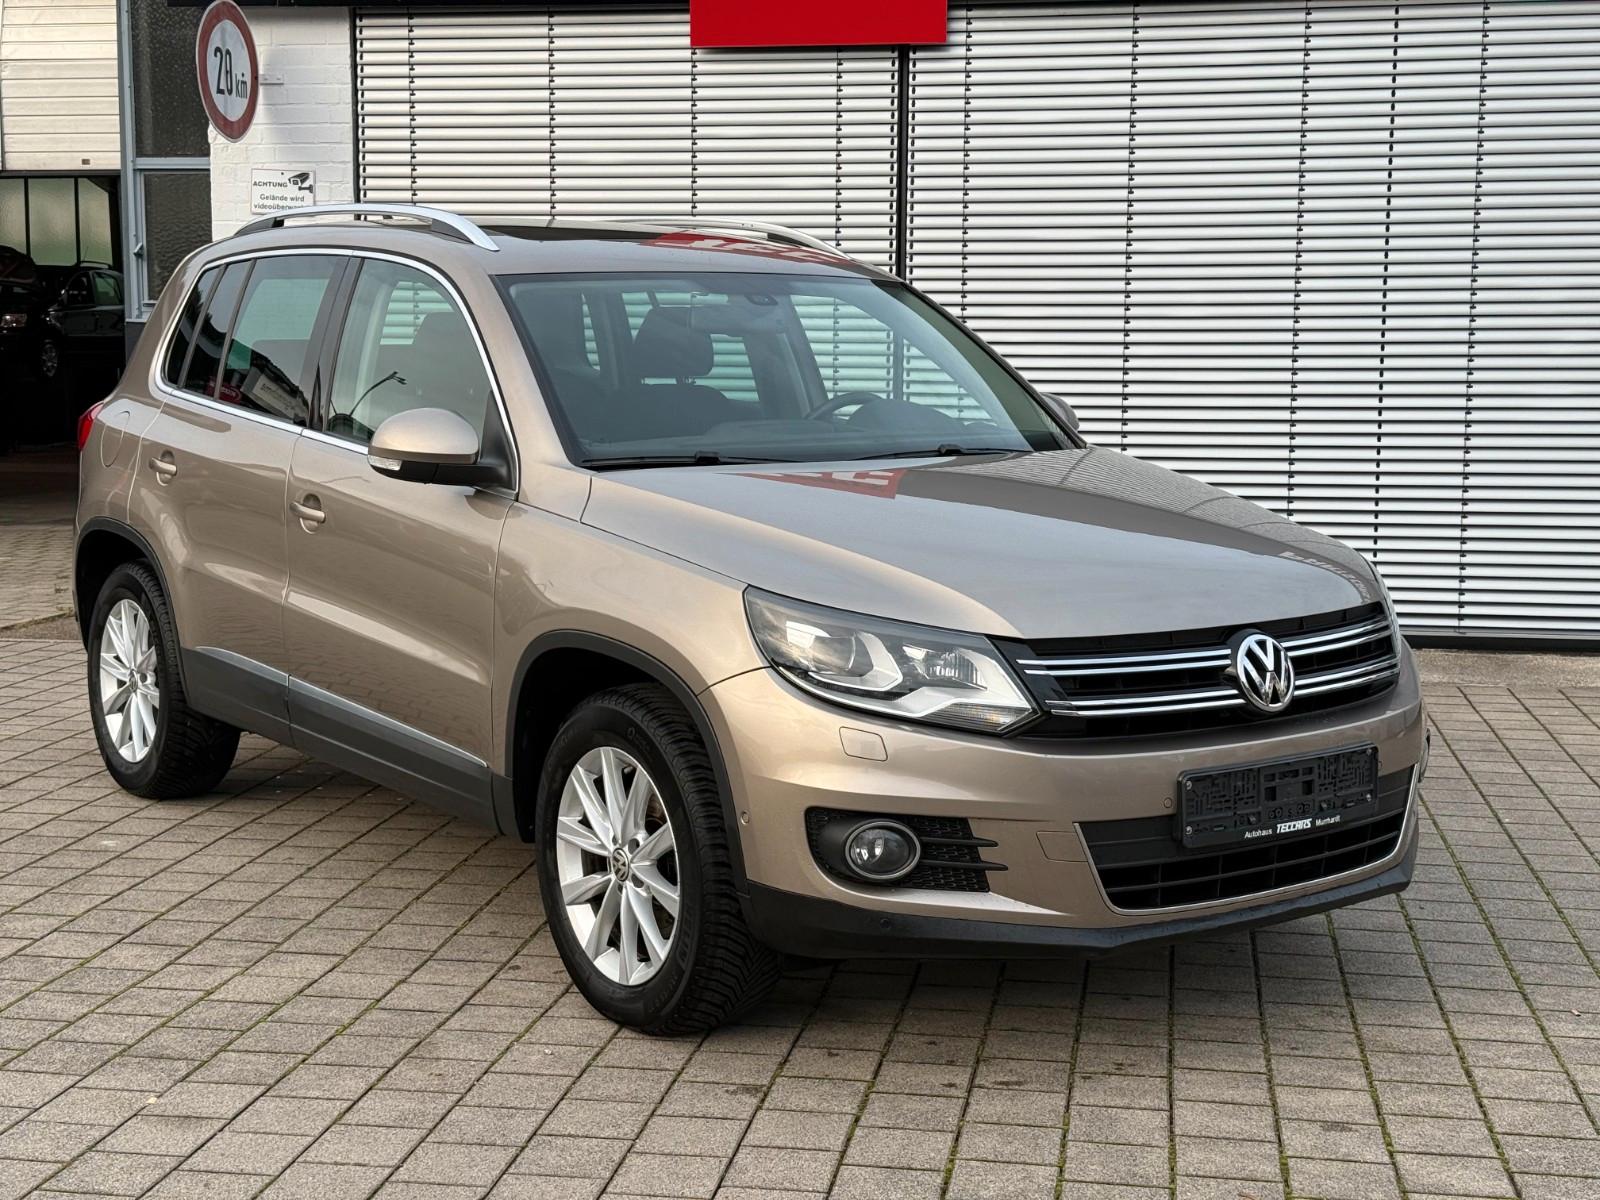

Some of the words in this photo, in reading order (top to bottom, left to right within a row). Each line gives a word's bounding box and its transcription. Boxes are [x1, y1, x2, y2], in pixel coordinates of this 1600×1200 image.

[214, 46, 233, 96] 20
[235, 73, 248, 99] km
[1244, 828, 1273, 839] Autohaus
[1276, 818, 1312, 834] TECCARS
